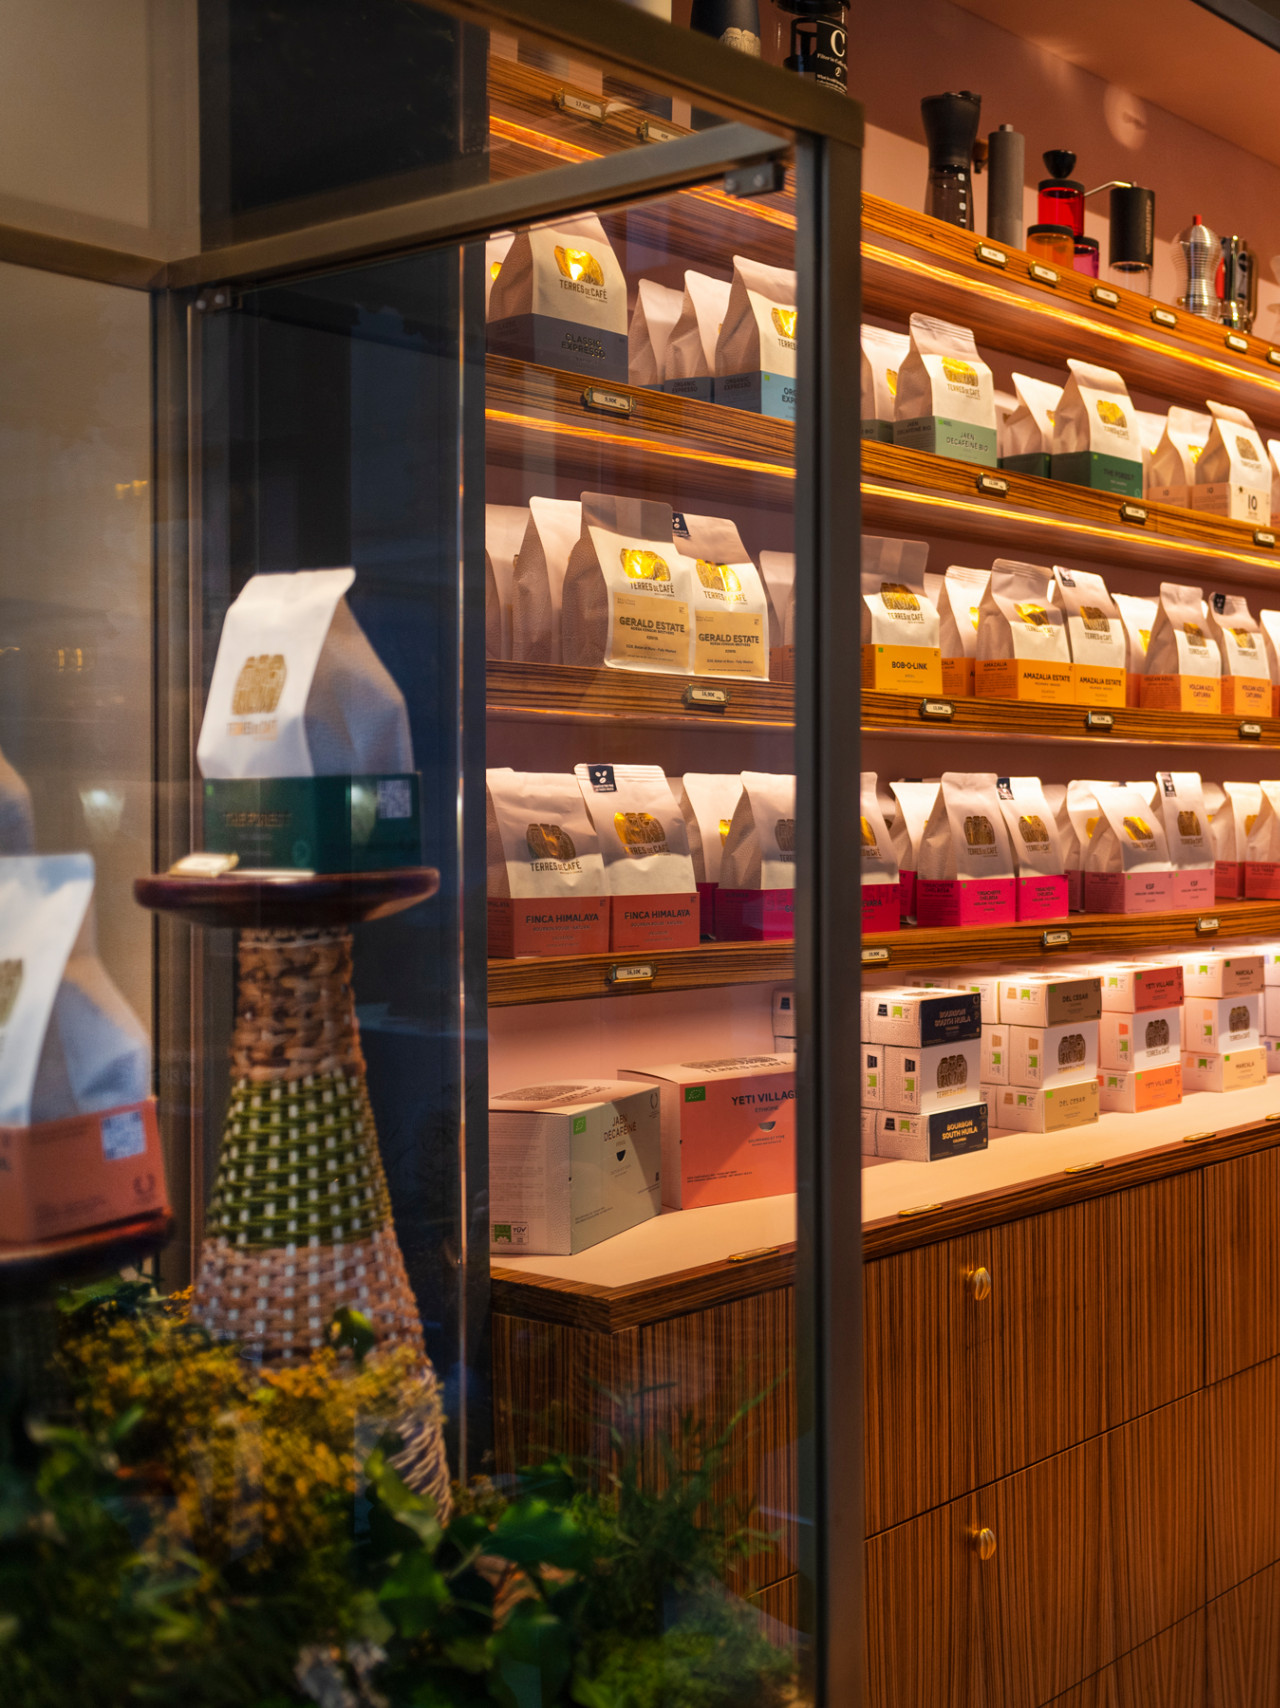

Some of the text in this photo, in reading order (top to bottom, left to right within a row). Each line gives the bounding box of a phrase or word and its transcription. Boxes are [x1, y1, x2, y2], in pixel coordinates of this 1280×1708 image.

[559, 279, 584, 295] TERRES
[590, 288, 607, 300] CAFÉ
[565, 333, 600, 346] CLASSIC
[561, 342, 605, 359] EXPRESSO
[1247, 494, 1258, 511] 10
[630, 582, 653, 593] TERRES
[658, 583, 675, 594] CAFÉ
[619, 616, 686, 633] GERALD ESTATE
[698, 633, 760, 644] GERALD ESTATE
[1023, 672, 1071, 682] AMAZALIA ESTATE
[1079, 677, 1122, 687] AMAZALIA ESTATE
[530, 861, 557, 872] TERRES
[563, 860, 582, 870] CAFÉ
[525, 913, 600, 924] FINCA HIMALAYA
[624, 909, 691, 920] FINCA HIMALAYA
[1061, 995, 1072, 1003] DEL
[731, 1094, 755, 1106] YETI
[946, 1119, 973, 1131] BOURBON
[941, 1125, 978, 1140] SOUTH HUILA
